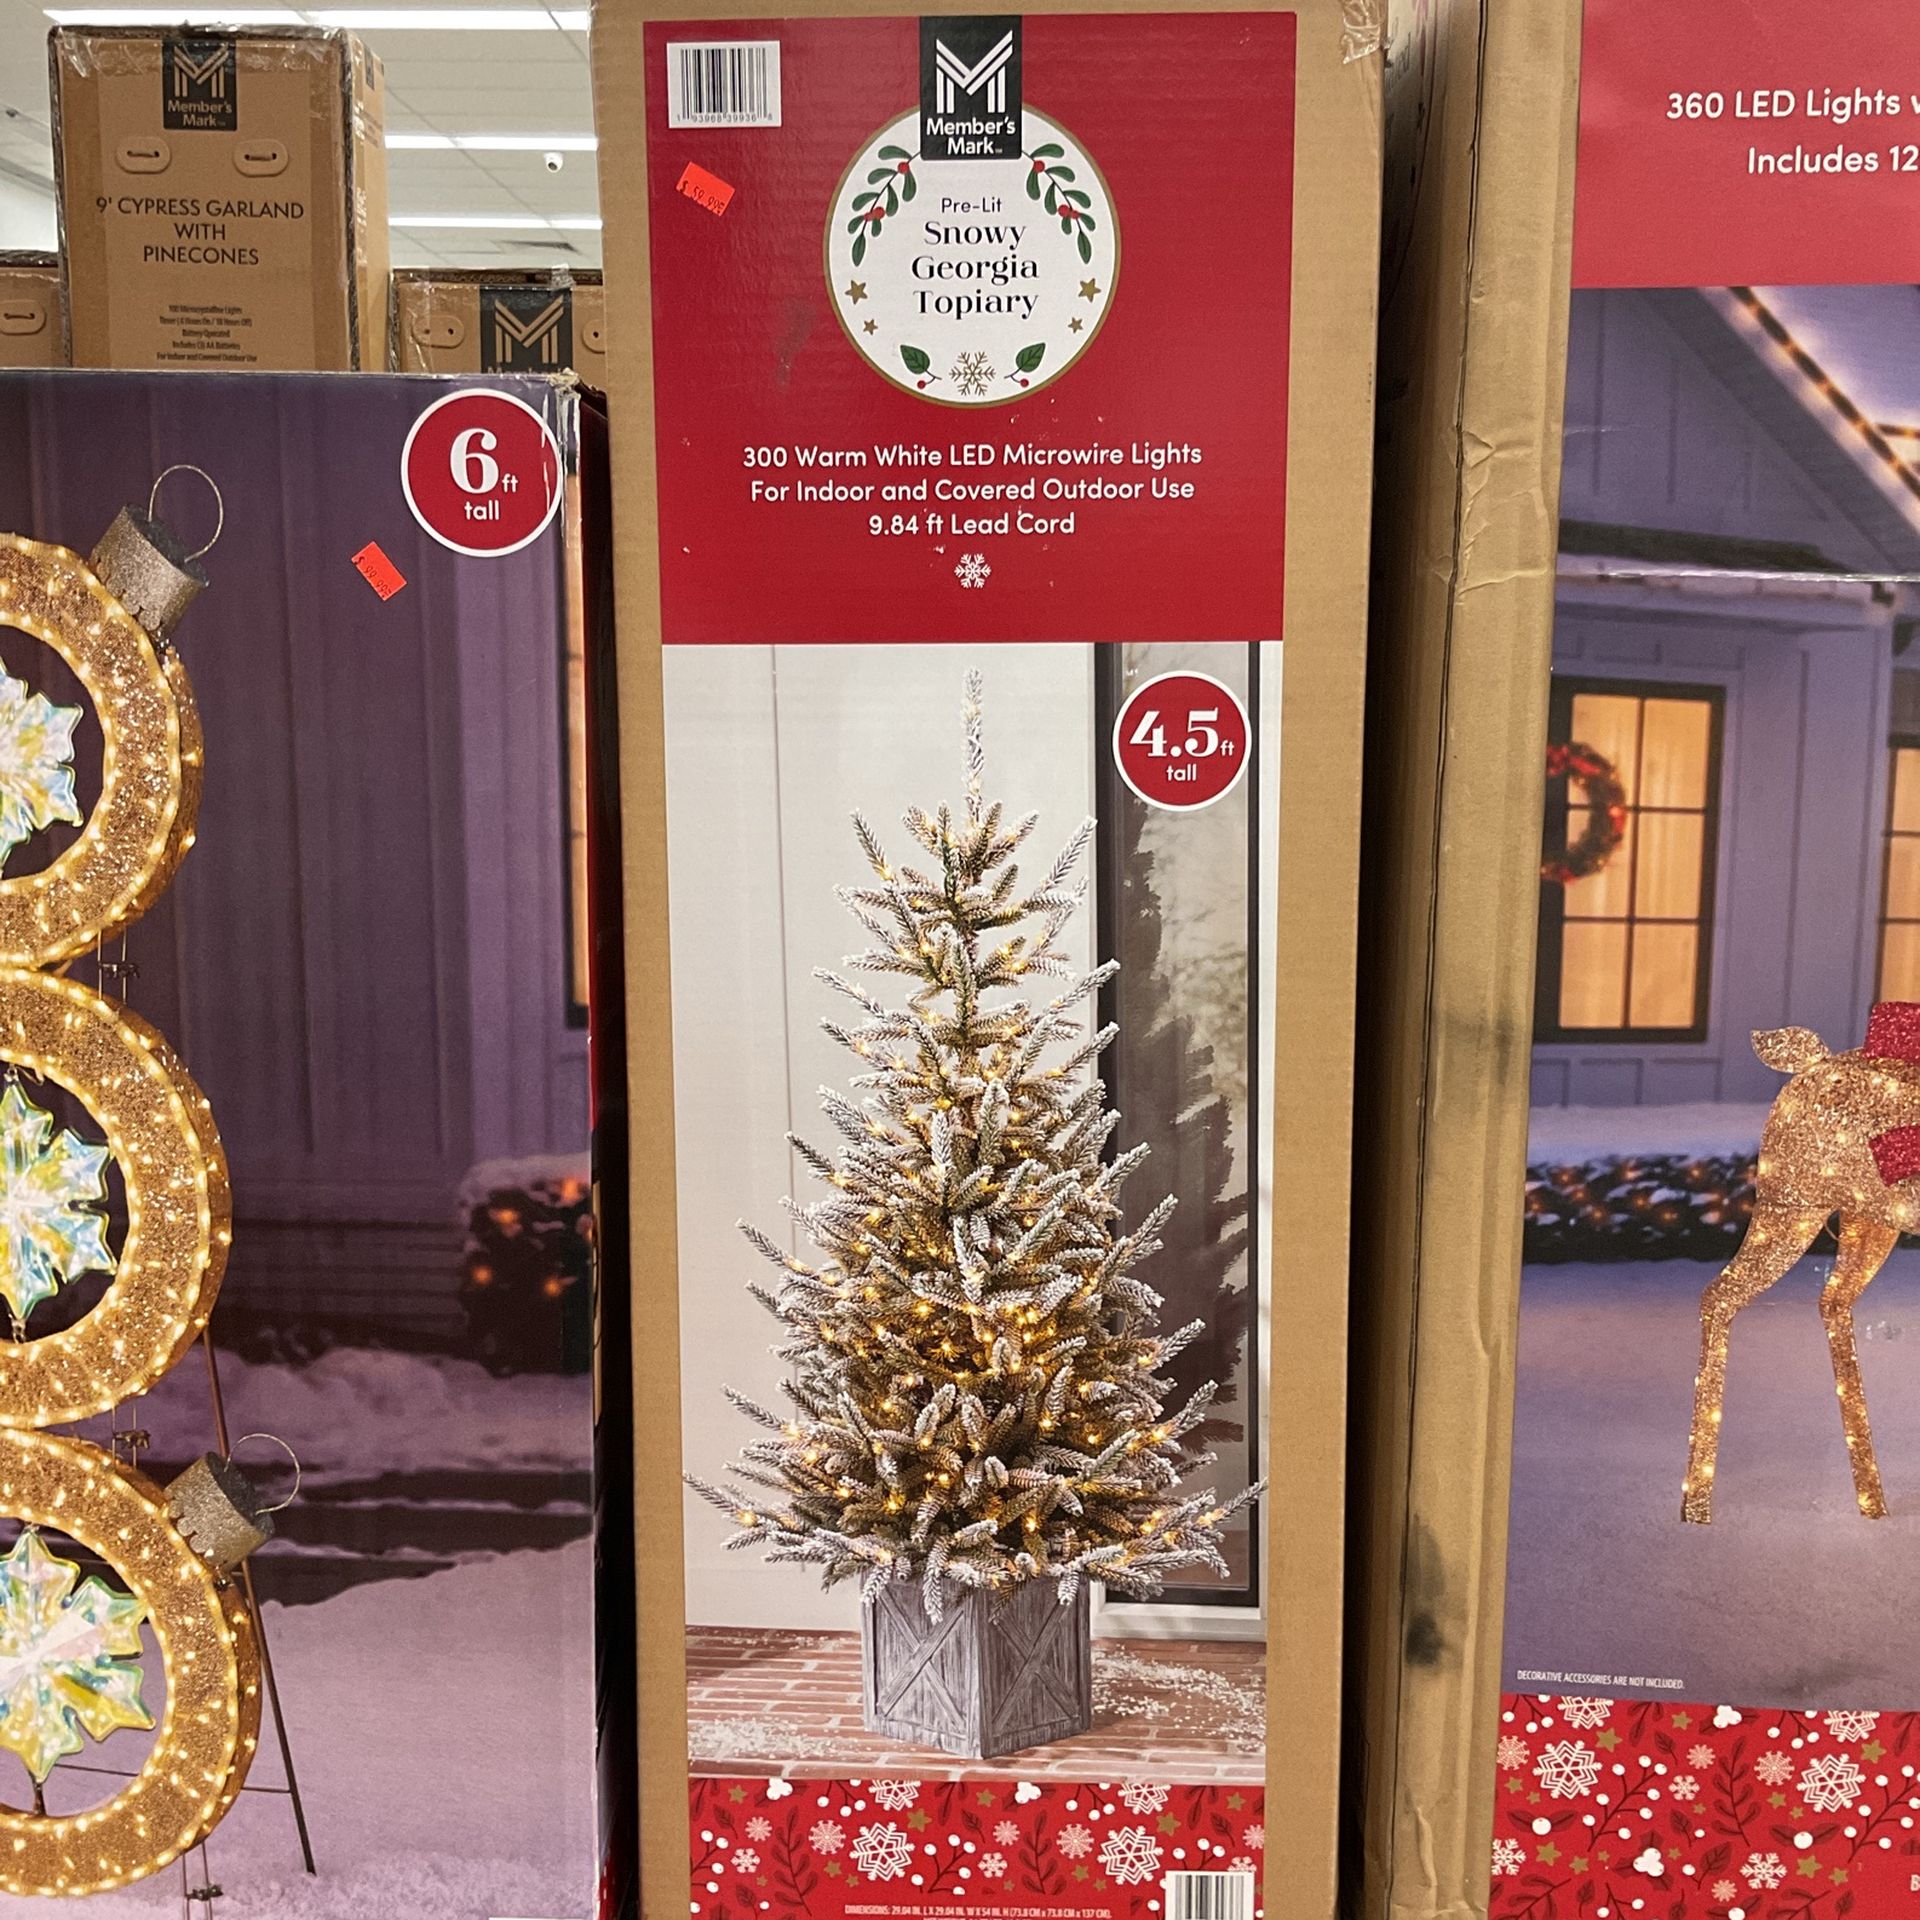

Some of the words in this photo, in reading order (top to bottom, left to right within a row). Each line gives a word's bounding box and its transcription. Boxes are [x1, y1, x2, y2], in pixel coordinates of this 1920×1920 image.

[168, 100, 232, 114] Member's
[1666, 92, 1724, 119] 360
[1735, 90, 1796, 118] LED
[1806, 87, 1901, 124] Lights
[183, 114, 216, 126] Mark
[926, 116, 1016, 136] Member's
[947, 136, 994, 155] Mark
[1748, 144, 1879, 174] Includes
[1889, 145, 1919, 172] 12
[96, 197, 112, 214] 9'
[118, 197, 200, 216] CYPRESS
[206, 200, 304, 219] GARLAND
[941, 197, 1002, 213] Pre-Lit
[174, 223, 226, 240] WITH
[924, 220, 1027, 250] Snowy
[144, 245, 259, 265] PINECONES
[911, 254, 1040, 286] Georgia
[913, 290, 1040, 320] Topiary
[450, 428, 499, 494] 6
[502, 473, 518, 493] ft
[743, 447, 788, 468] 300
[794, 446, 867, 468] Warm
[874, 444, 942, 466] White
[950, 444, 996, 466] LED
[1003, 442, 1124, 466] Microwire
[1132, 442, 1202, 470] Lights
[751, 480, 790, 502] For
[797, 479, 876, 502] Indoor
[881, 478, 928, 501] and
[934, 478, 1036, 500] Covered
[1042, 477, 1144, 500] Outdoor
[1151, 477, 1194, 498] Use
[464, 500, 500, 521] tall
[869, 514, 919, 536] 9.84
[926, 513, 944, 534] ft
[951, 512, 1009, 534] Lead
[1016, 512, 1075, 534] Cord
[1129, 706, 1219, 758] 4.5
[1220, 740, 1234, 756] ft
[1166, 764, 1197, 782] tall
[1516, 1670, 1562, 1682] DECORATIVE
[1564, 1673, 1612, 1685] ACCESSORIES
[1613, 1676, 1628, 1686] ARE
[1629, 1677, 1644, 1687] NOT
[1646, 1678, 1685, 1690] INCLUDED.
